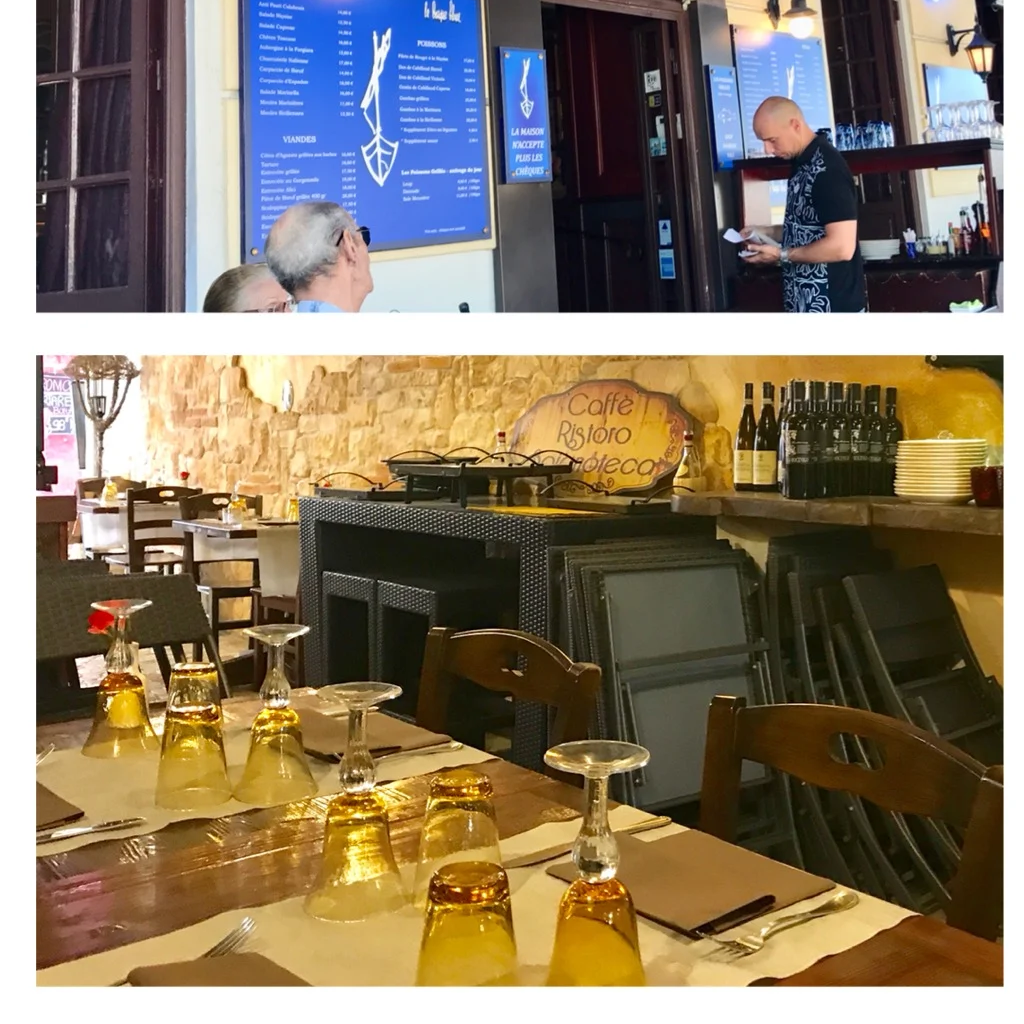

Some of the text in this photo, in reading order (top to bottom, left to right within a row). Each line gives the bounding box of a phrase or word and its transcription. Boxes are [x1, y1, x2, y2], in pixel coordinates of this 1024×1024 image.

[511, 127, 544, 136] LA MAISON
[515, 153, 543, 162] PLUS LES
[568, 392, 634, 416] Caffè
[557, 420, 632, 452] Ristoro
